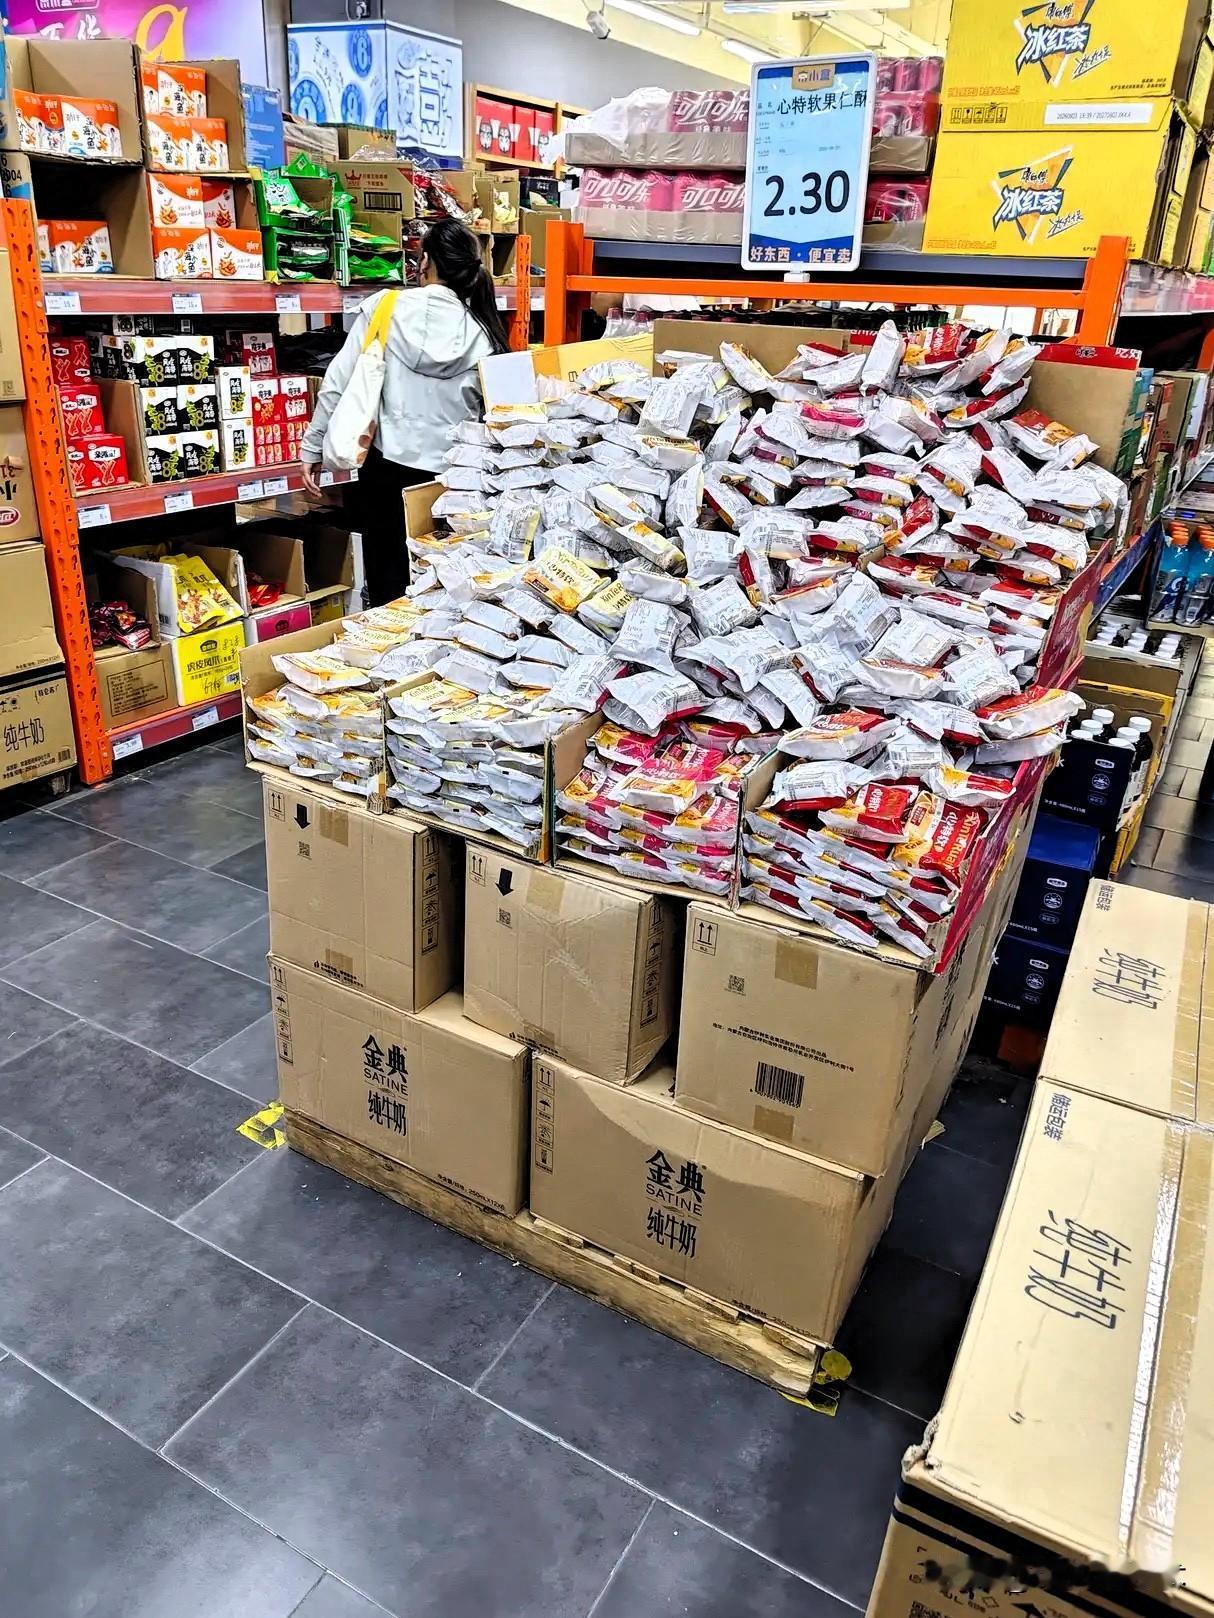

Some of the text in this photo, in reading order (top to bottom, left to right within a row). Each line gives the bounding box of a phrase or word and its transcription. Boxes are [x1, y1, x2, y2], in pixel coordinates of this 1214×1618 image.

[1017, 25, 1090, 69] 冰红茶
[764, 170, 850, 217] 2.30
[994, 187, 1064, 230] 冰红茶
[4, 718, 45, 752] 纯牛奶
[1092, 947, 1167, 1010] 纯牛奶
[361, 1034, 409, 1084] 金典
[364, 1067, 409, 1096] SATINE
[367, 1090, 407, 1137] 纯牛奶
[1043, 1092, 1073, 1142] 储运包装
[645, 1149, 706, 1204] 金典
[646, 1183, 703, 1217] SATINE
[646, 1206, 697, 1259] 纯牛奶
[1025, 1209, 1132, 1330] 纯牛奶
